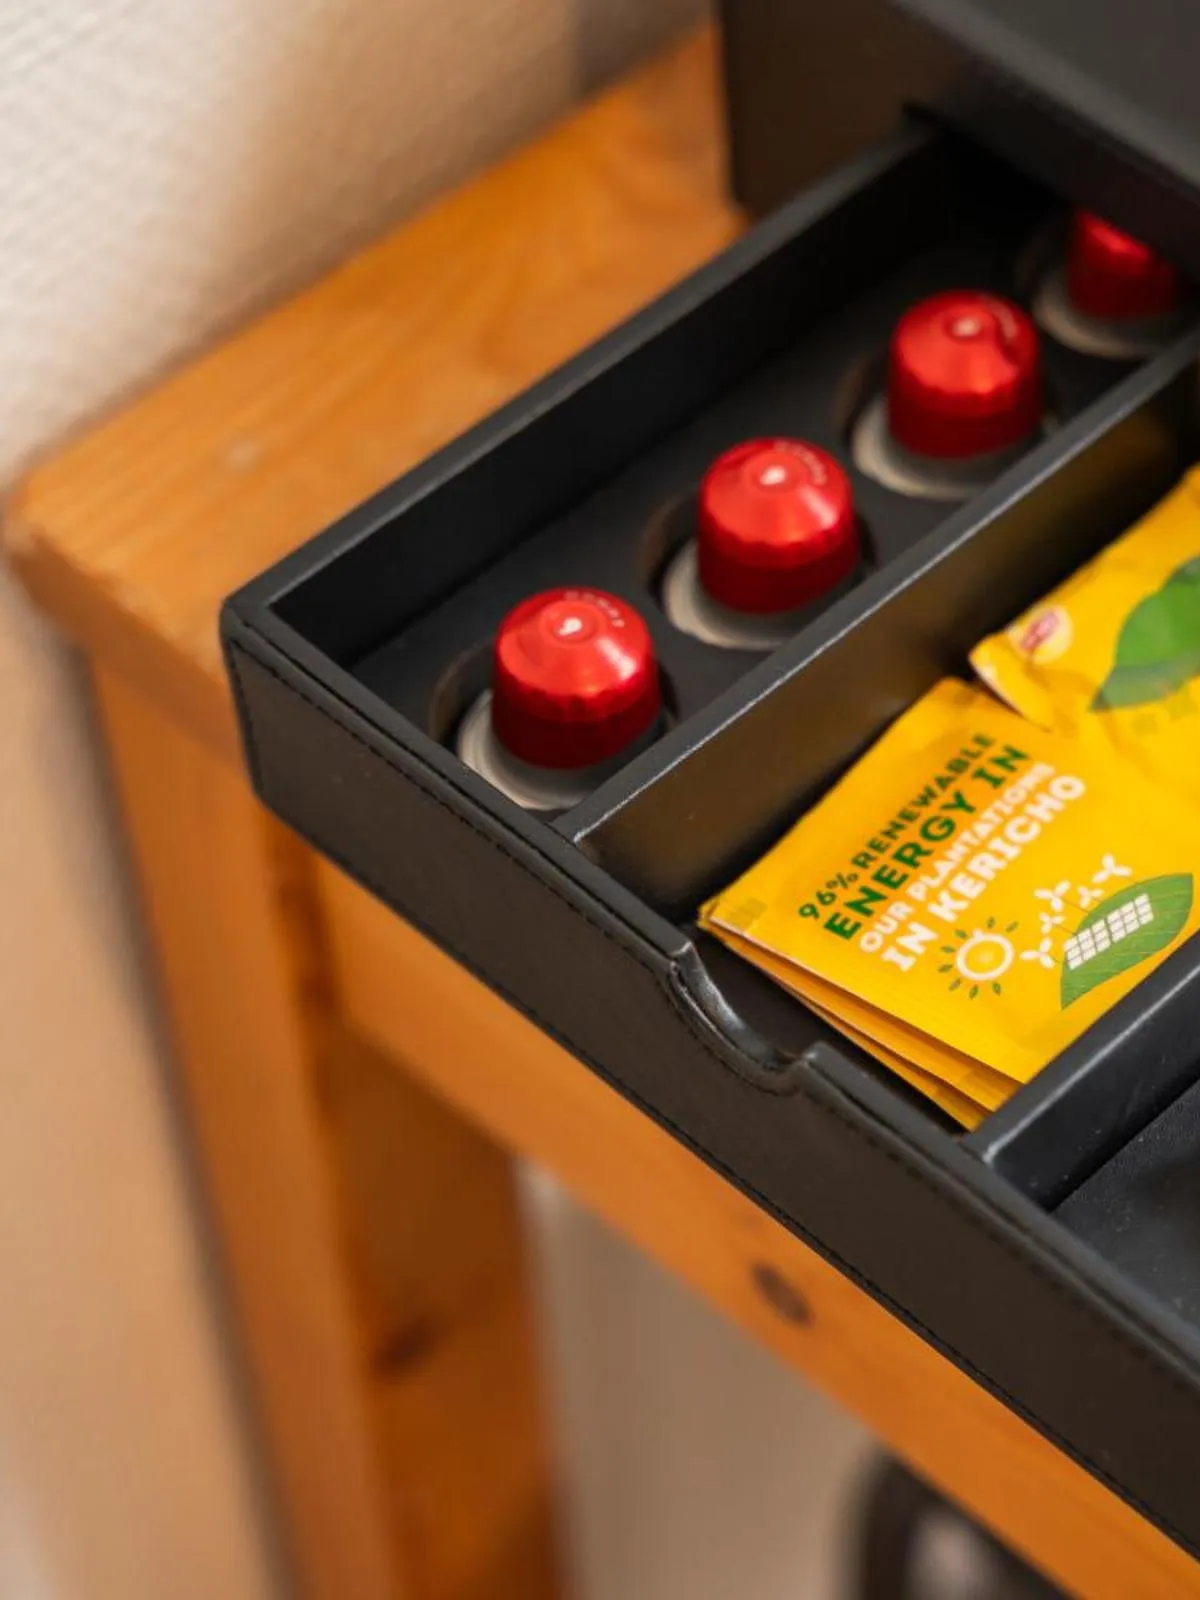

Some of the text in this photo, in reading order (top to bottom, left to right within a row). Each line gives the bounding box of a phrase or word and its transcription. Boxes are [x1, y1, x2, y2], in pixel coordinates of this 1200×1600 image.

[798, 733, 996, 921] 96% RENEWABLE
[823, 744, 1030, 941] ENERGY IN
[859, 901, 916, 954] OUR
[904, 762, 1056, 903] PLANTATIONS
[880, 920, 940, 973] IN
[927, 775, 1087, 923] KERICHO
